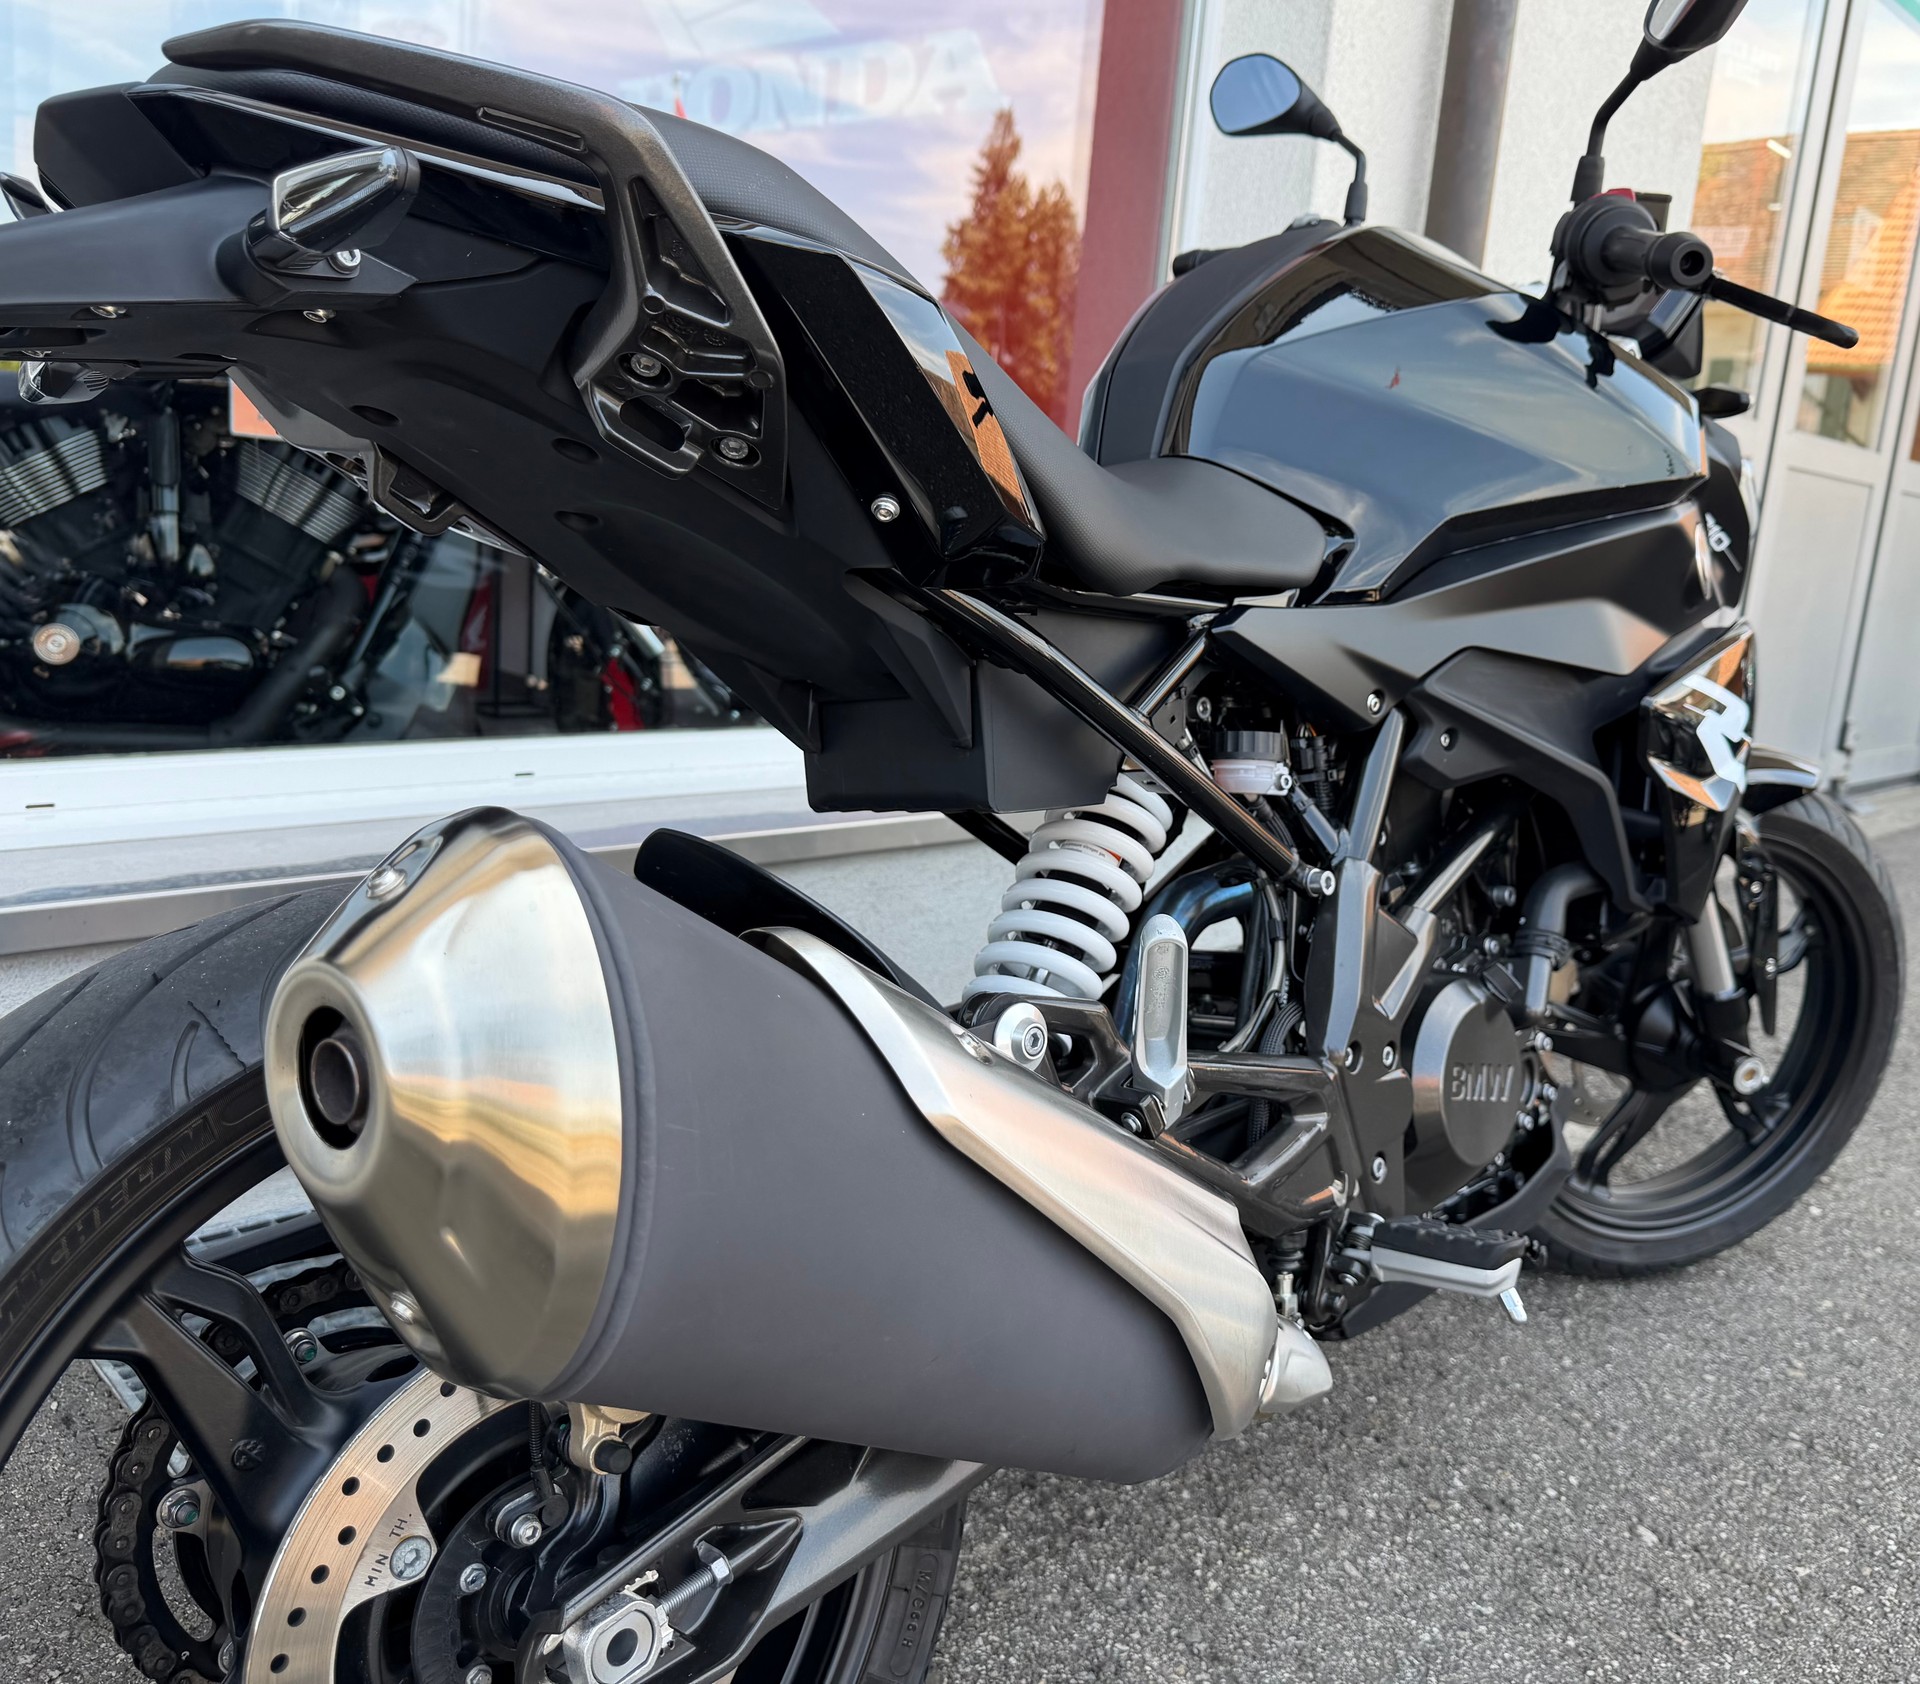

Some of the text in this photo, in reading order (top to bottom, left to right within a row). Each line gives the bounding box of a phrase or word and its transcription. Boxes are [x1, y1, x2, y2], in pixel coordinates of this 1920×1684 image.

[1450, 1062, 1515, 1102] BMW
[364, 1512, 413, 1587] MIN TH.
